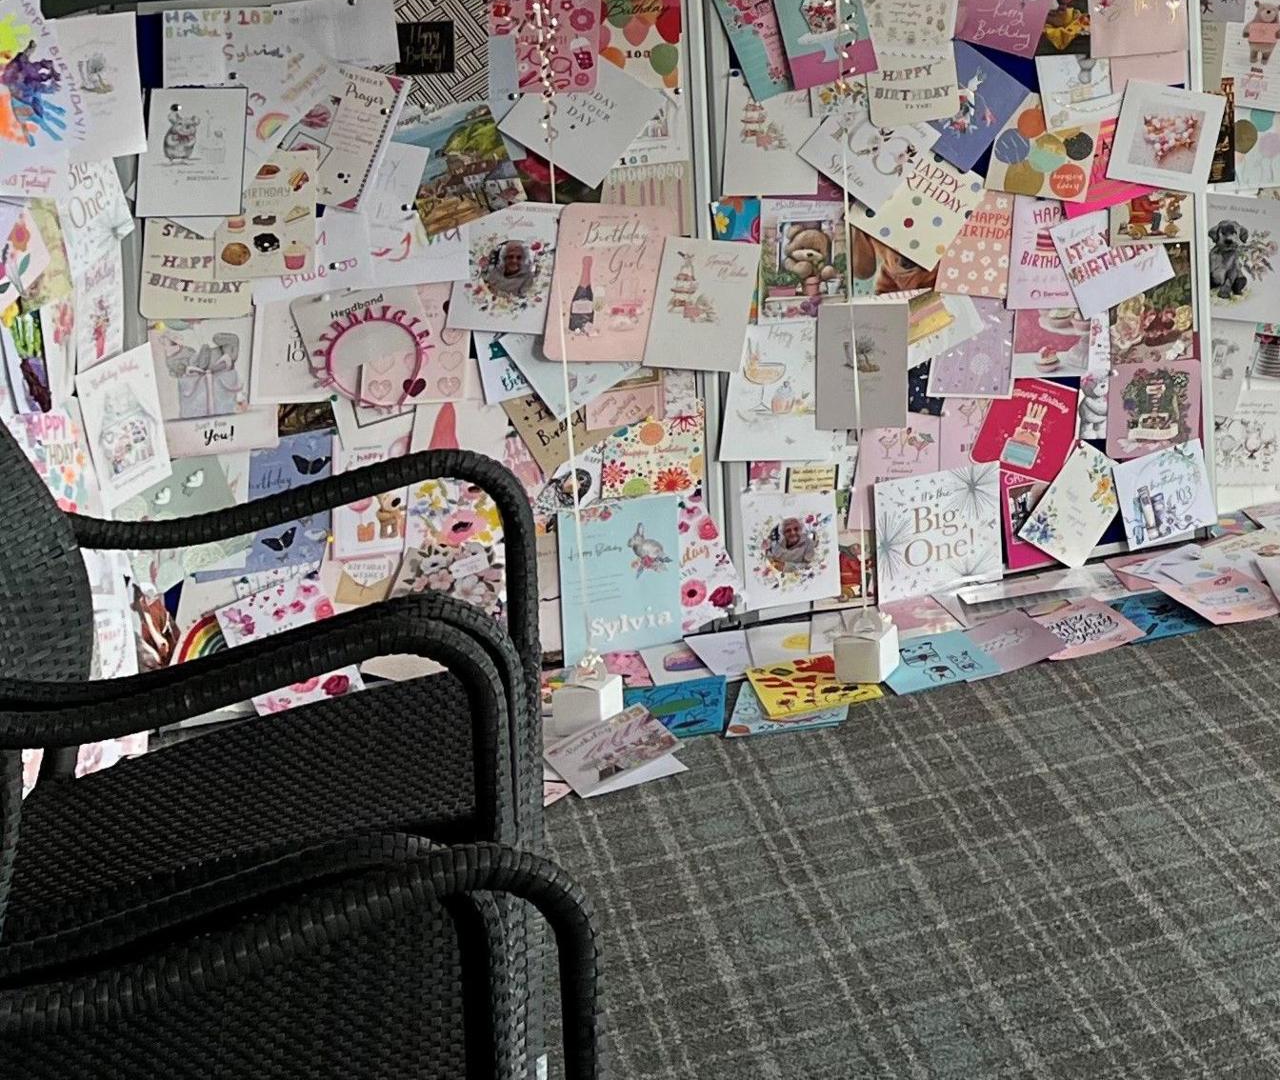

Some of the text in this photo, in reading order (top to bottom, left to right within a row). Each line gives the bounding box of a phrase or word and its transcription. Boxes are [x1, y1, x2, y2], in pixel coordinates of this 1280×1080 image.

[165, 10, 231, 25] HAPPY
[973, 19, 1031, 51] Birthday
[625, 49, 652, 59] 103
[881, 65, 933, 82] HAPPY
[344, 81, 387, 108] Prayer
[874, 85, 951, 101] BIRTHDAY
[566, 106, 597, 128] DAY
[580, 99, 611, 123] YOUR
[618, 154, 649, 167] 103
[67, 179, 111, 230] One!
[969, 209, 1011, 226] HAPPY
[1033, 206, 1062, 226] HAP
[582, 220, 649, 246] Birthday
[608, 243, 647, 286] Girl
[1020, 250, 1063, 269] BIRTHD
[148, 276, 244, 297] BIRTHDAY
[330, 294, 384, 320] Headband
[203, 424, 235, 446] You!
[911, 504, 960, 536] Big
[903, 527, 976, 568] One!
[589, 606, 674, 639] Sylvia
